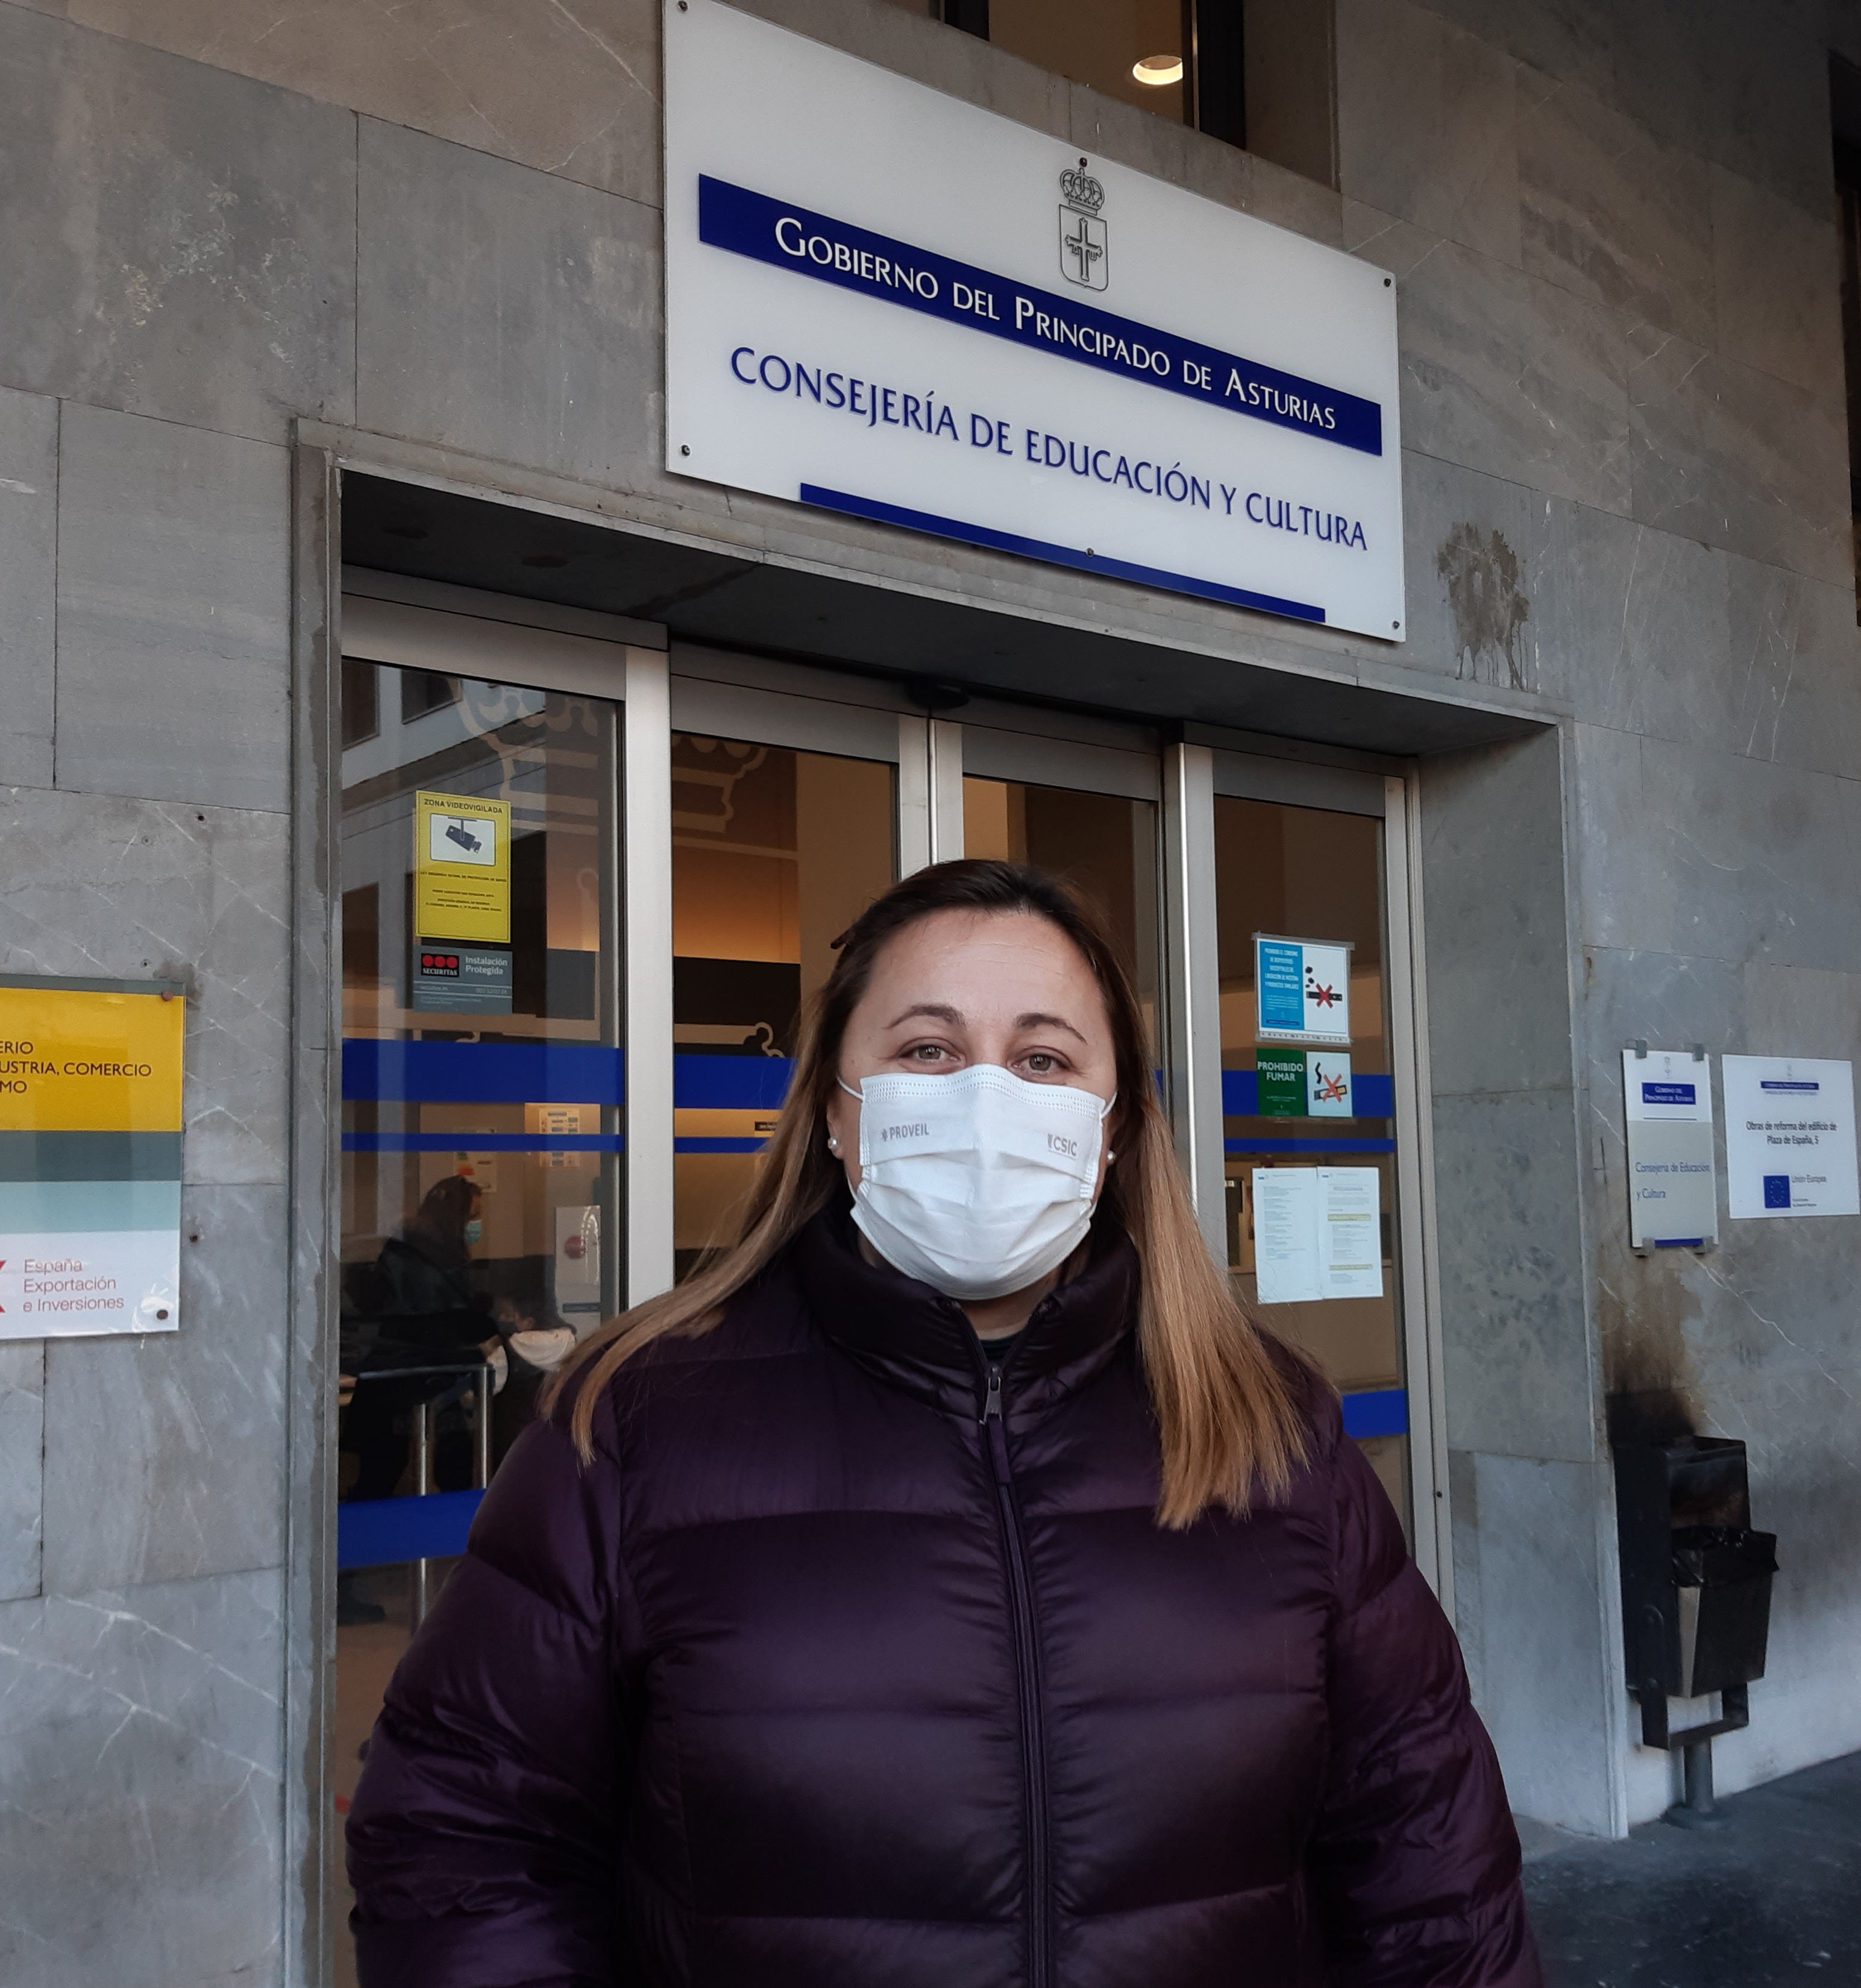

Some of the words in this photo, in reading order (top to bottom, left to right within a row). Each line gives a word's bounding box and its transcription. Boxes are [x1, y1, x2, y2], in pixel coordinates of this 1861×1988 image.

[953, 282, 1000, 321] DEL
[1183, 360, 1212, 391] DE
[731, 347, 959, 441] CONSEJERÍA
[971, 413, 1012, 456] DE
[1026, 429, 1210, 509] EDUCACIÓN
[1220, 483, 1237, 515] Y
[1246, 492, 1367, 550] CULTURA
[424, 799, 445, 807] ZONA
[447, 802, 503, 813] VIDEOVIGILADA
[465, 956, 508, 966] Instalación
[423, 967, 457, 976] SECURITAS
[465, 964, 503, 976] Protegida
[0, 1060, 60, 1076] USTRIA,
[63, 1062, 152, 1077] COMERCIO
[1257, 1061, 1304, 1072] PROHIBIDO
[1266, 1072, 1296, 1081] FUMAR
[0, 1080, 27, 1093] MO
[1746, 1121, 1764, 1130] Obras
[1765, 1121, 1772, 1130] de
[1774, 1121, 1797, 1130] reforma
[1798, 1121, 1807, 1130] del
[1809, 1121, 1828, 1131] edificio
[1830, 1121, 1837, 1131] de
[1767, 1135, 1782, 1144] Plaza
[1783, 1134, 1791, 1145] de
[1815, 1135, 1819, 1144] 5
[1053, 1136, 1078, 1157] CSIC
[1671, 1162, 1678, 1172] de
[1636, 1191, 1640, 1201] y
[1642, 1187, 1666, 1198] Cultura
[24, 1259, 83, 1275] España
[24, 1276, 116, 1295] Exportación
[23, 1301, 33, 1312] e
[38, 1296, 124, 1312] Inversiones
